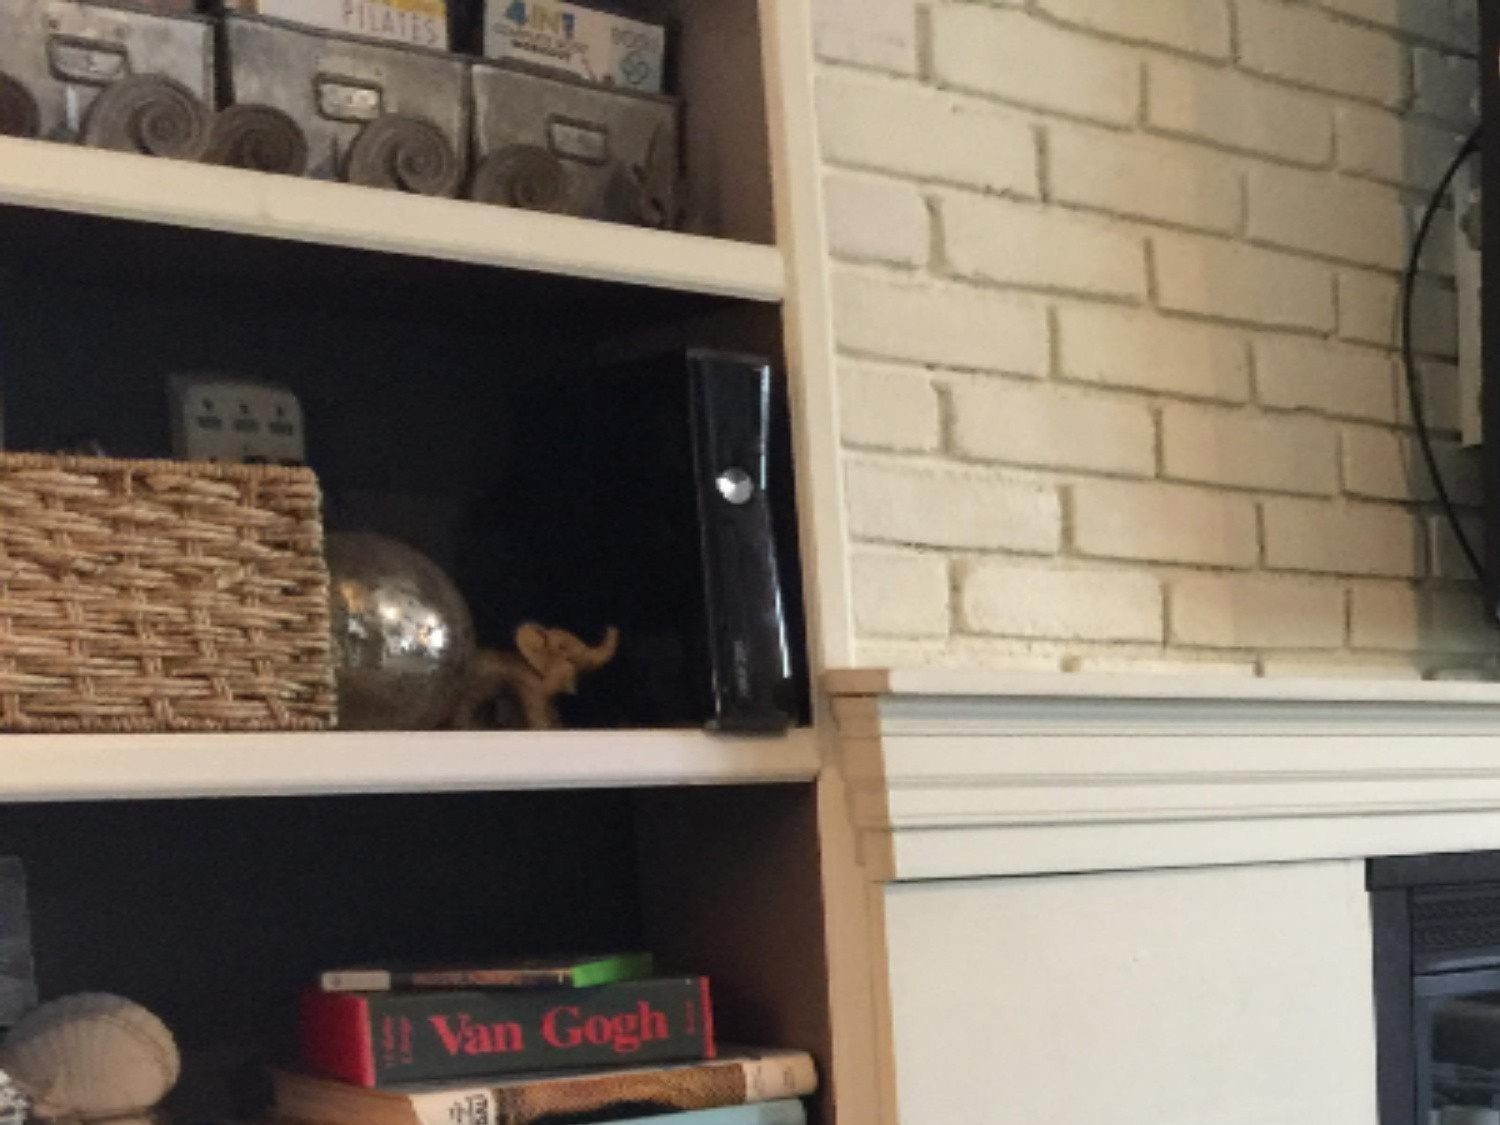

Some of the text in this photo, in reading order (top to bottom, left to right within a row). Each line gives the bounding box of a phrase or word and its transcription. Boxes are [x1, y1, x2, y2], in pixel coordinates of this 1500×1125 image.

[341, 0, 440, 45] PILATES
[427, 1011, 524, 1056] Van
[541, 1000, 669, 1053] Gogh
